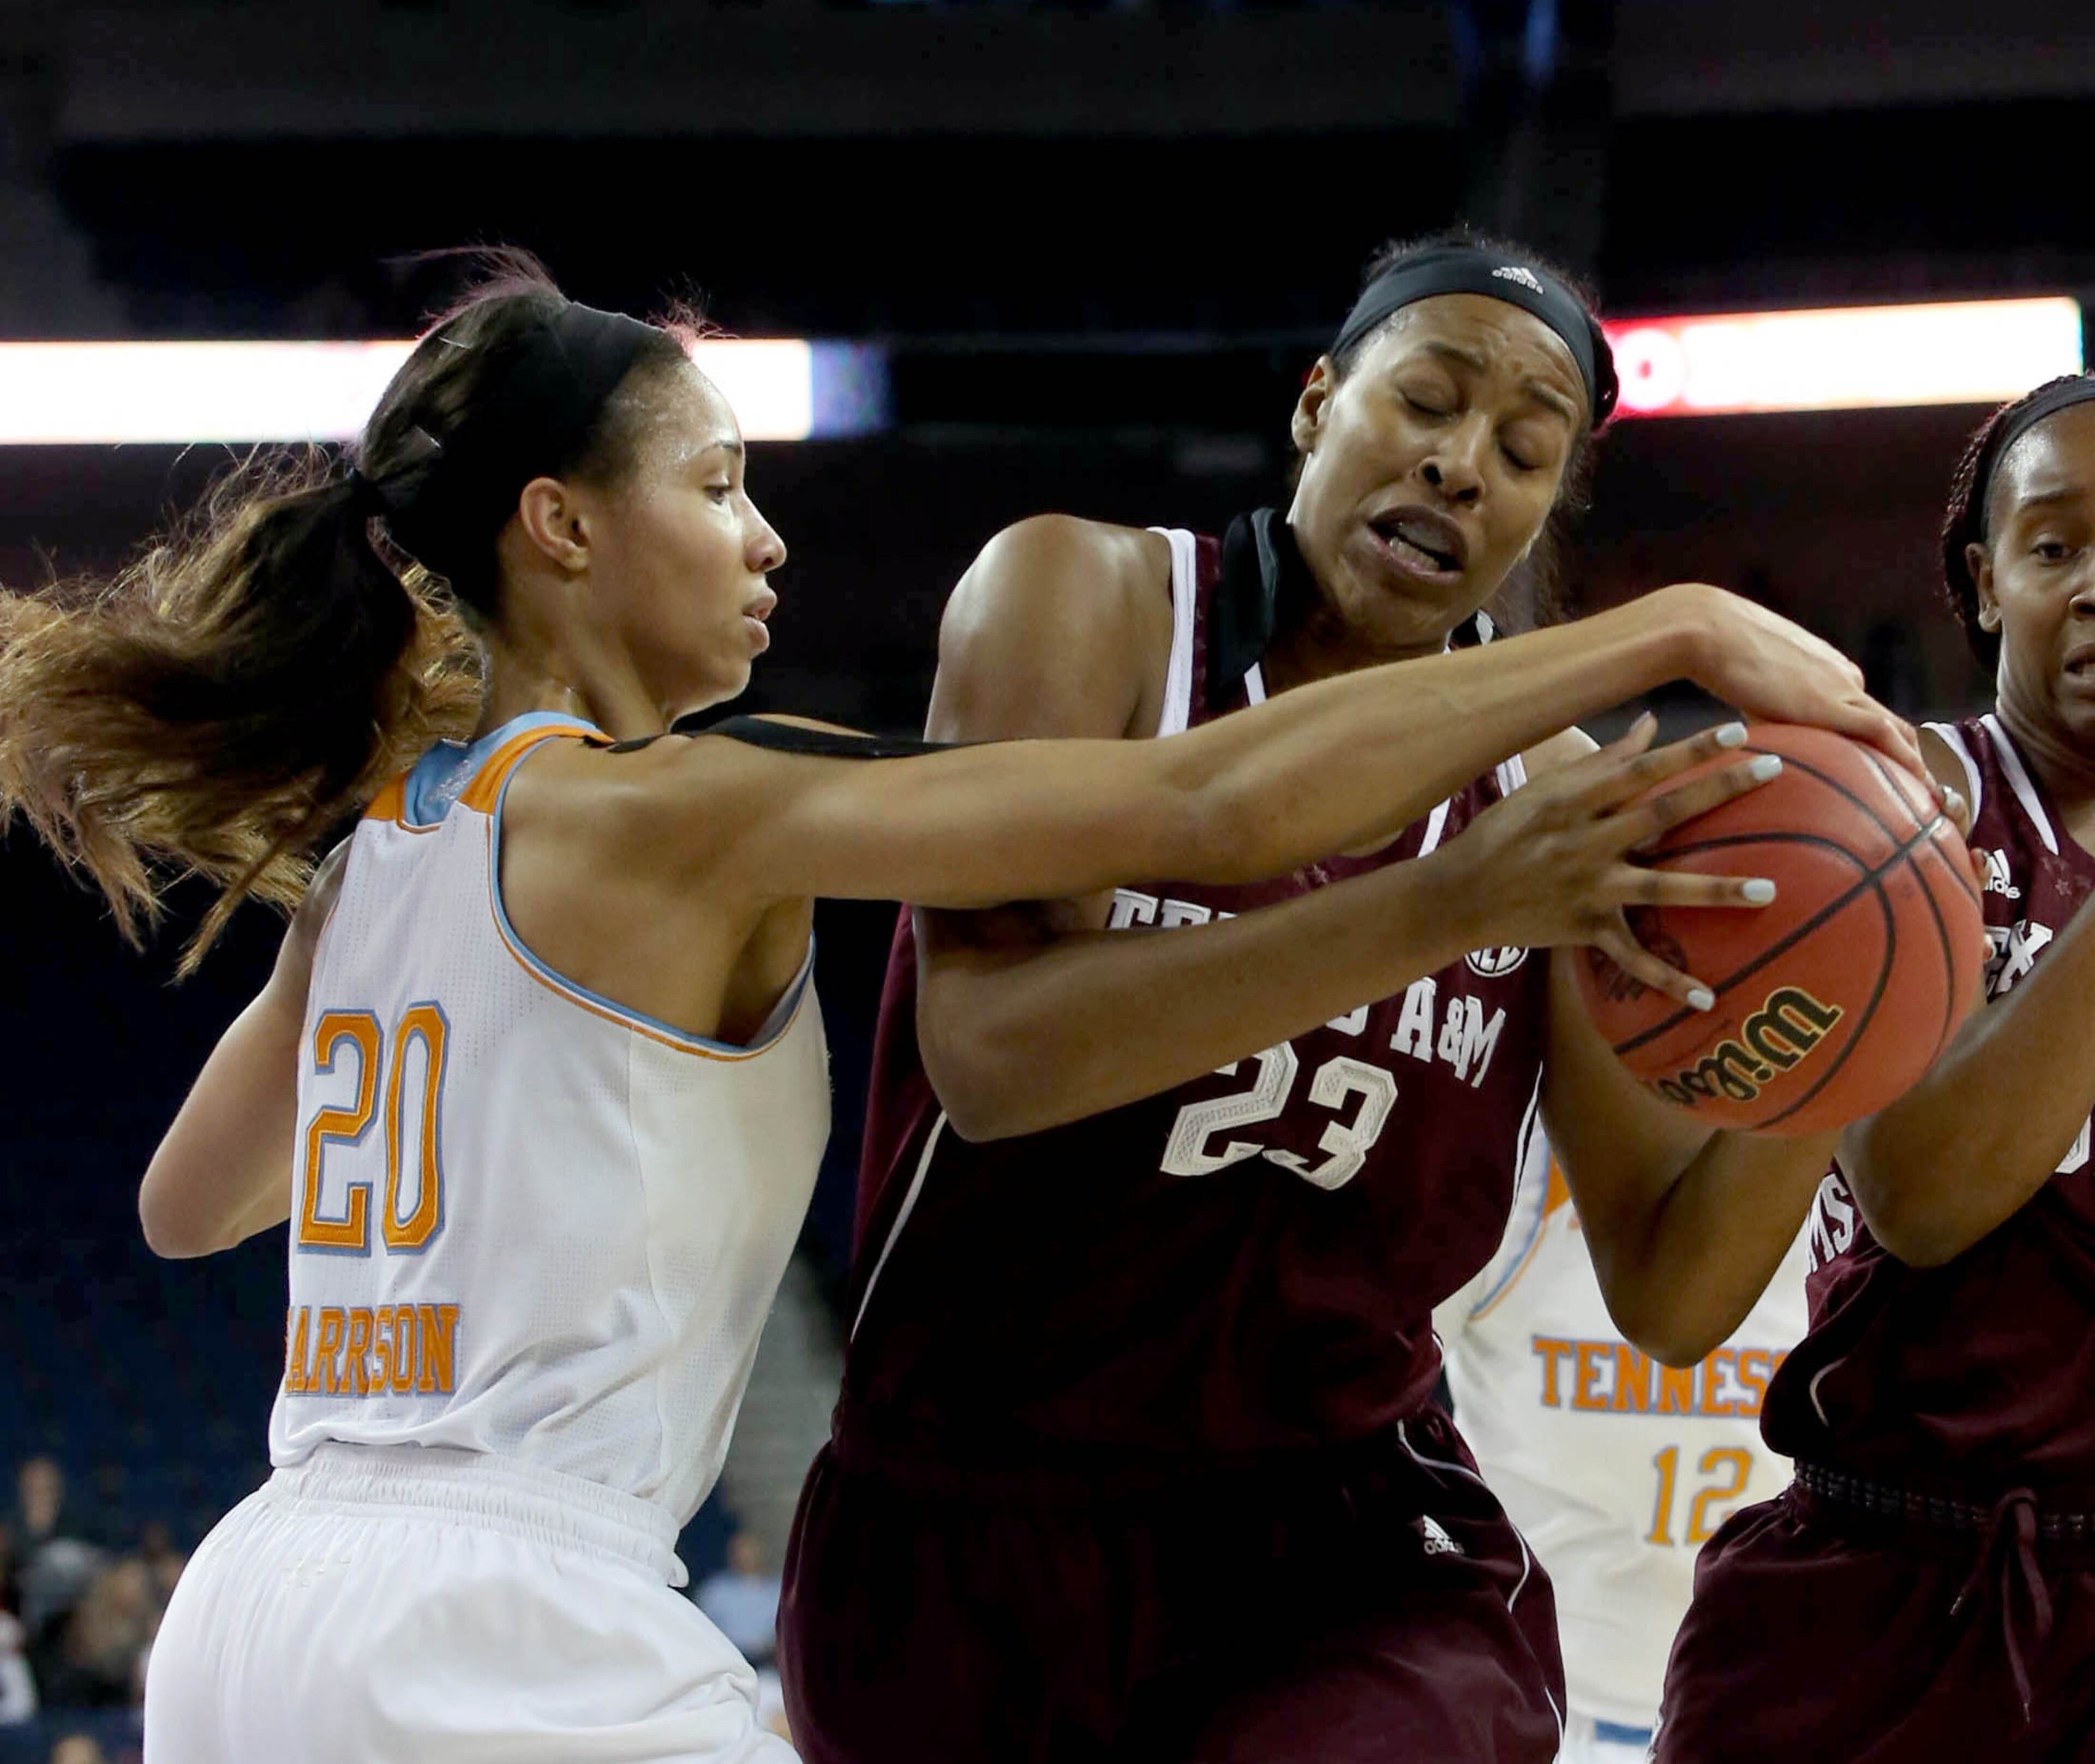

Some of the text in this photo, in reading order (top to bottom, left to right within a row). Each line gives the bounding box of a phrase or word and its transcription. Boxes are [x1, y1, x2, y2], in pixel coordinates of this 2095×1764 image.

[1390, 976, 1506, 1089] A&M
[1656, 986, 1845, 1105] Wilso
[297, 1000, 451, 1257] 20
[1159, 1041, 1398, 1191] 23
[284, 1303, 460, 1397] ARRSON
[1531, 1335, 1792, 1420] TENNES
[1644, 1445, 1753, 1546] 12
